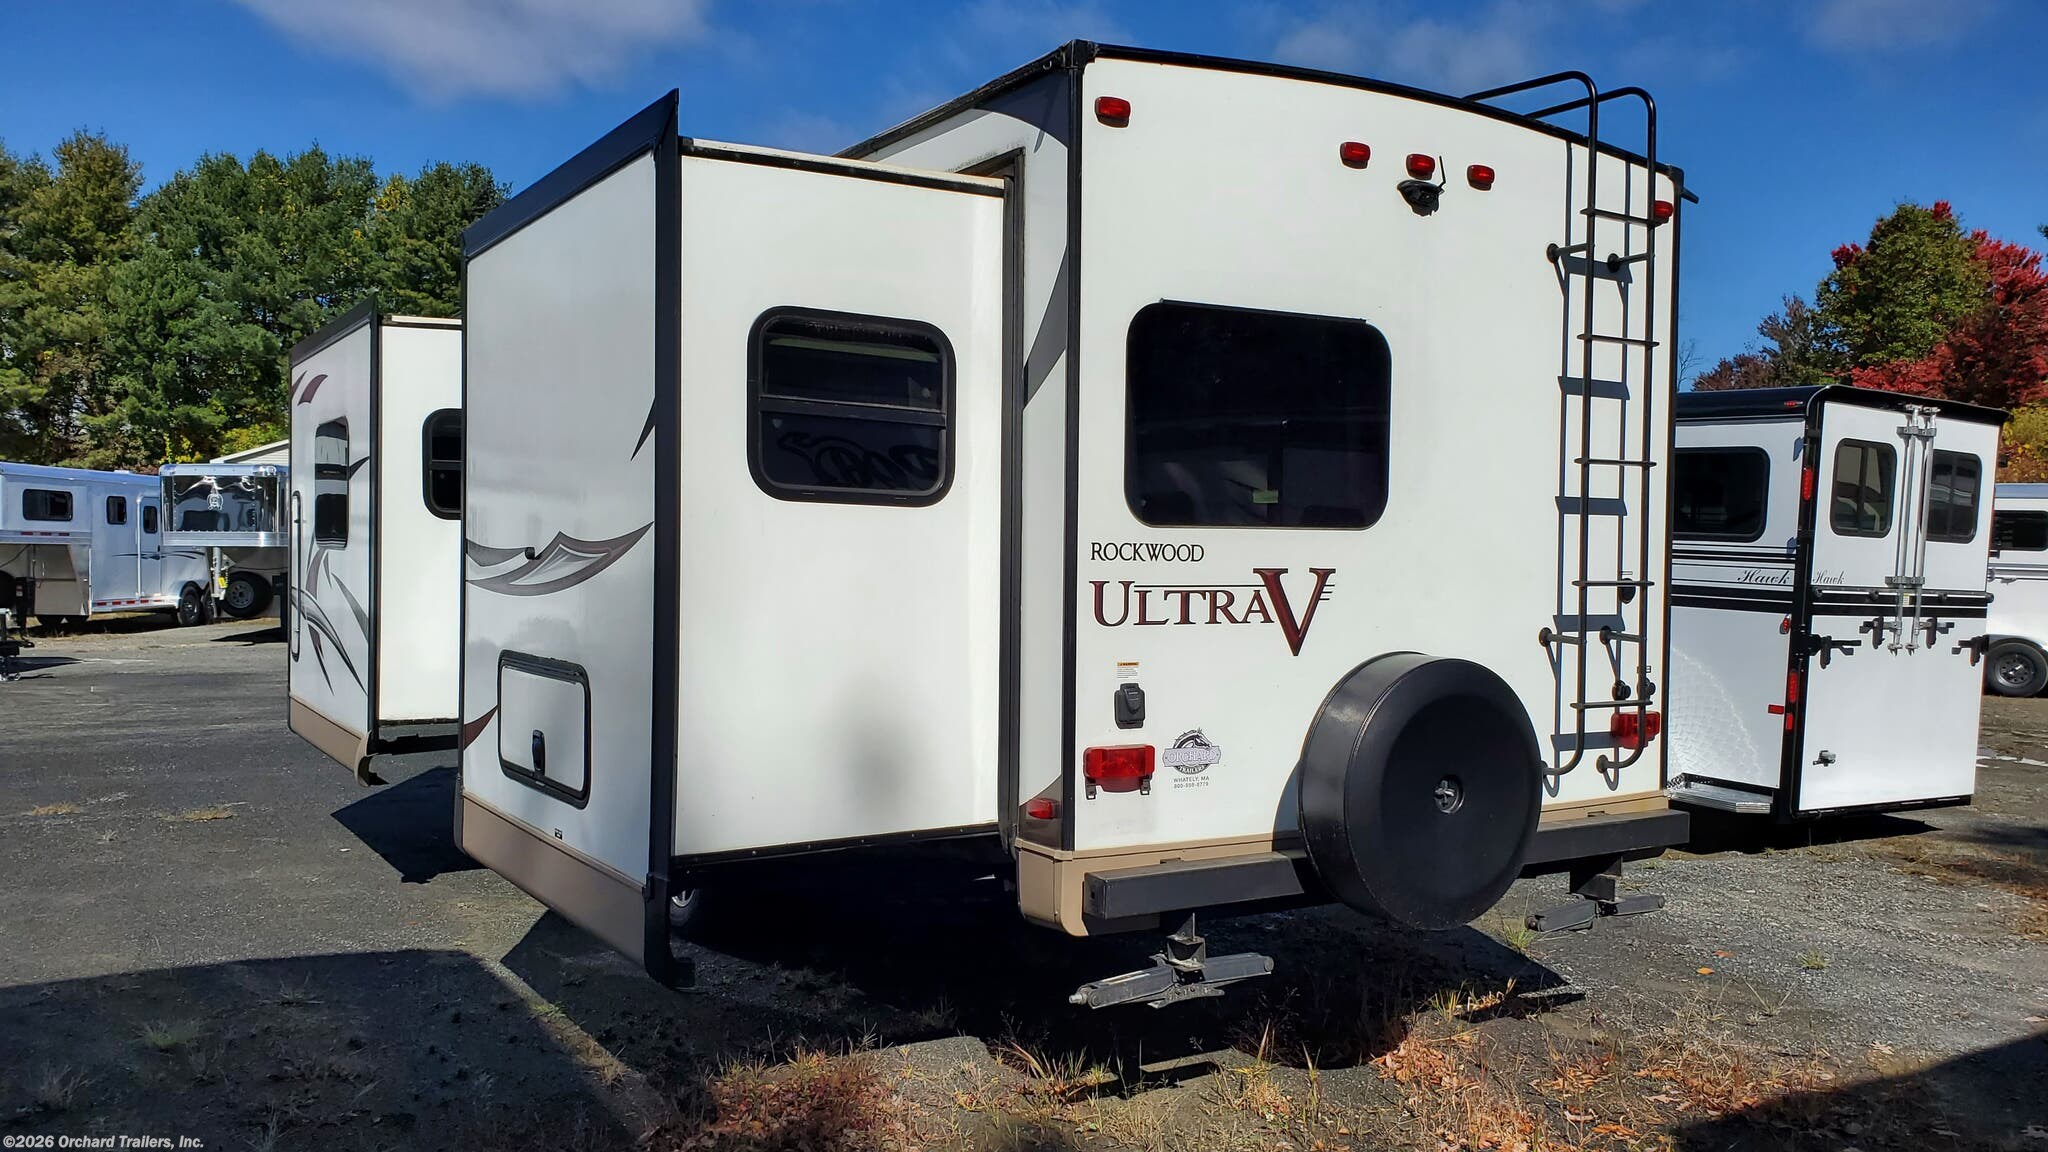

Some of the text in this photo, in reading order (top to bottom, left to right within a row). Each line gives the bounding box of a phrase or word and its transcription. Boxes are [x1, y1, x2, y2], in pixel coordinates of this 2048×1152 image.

[1090, 542, 1205, 562] ROCKWOOD
[1737, 569, 1790, 585] Hawk
[1812, 569, 1845, 585] Hawk
[1167, 749, 1216, 763] ORCHARD
